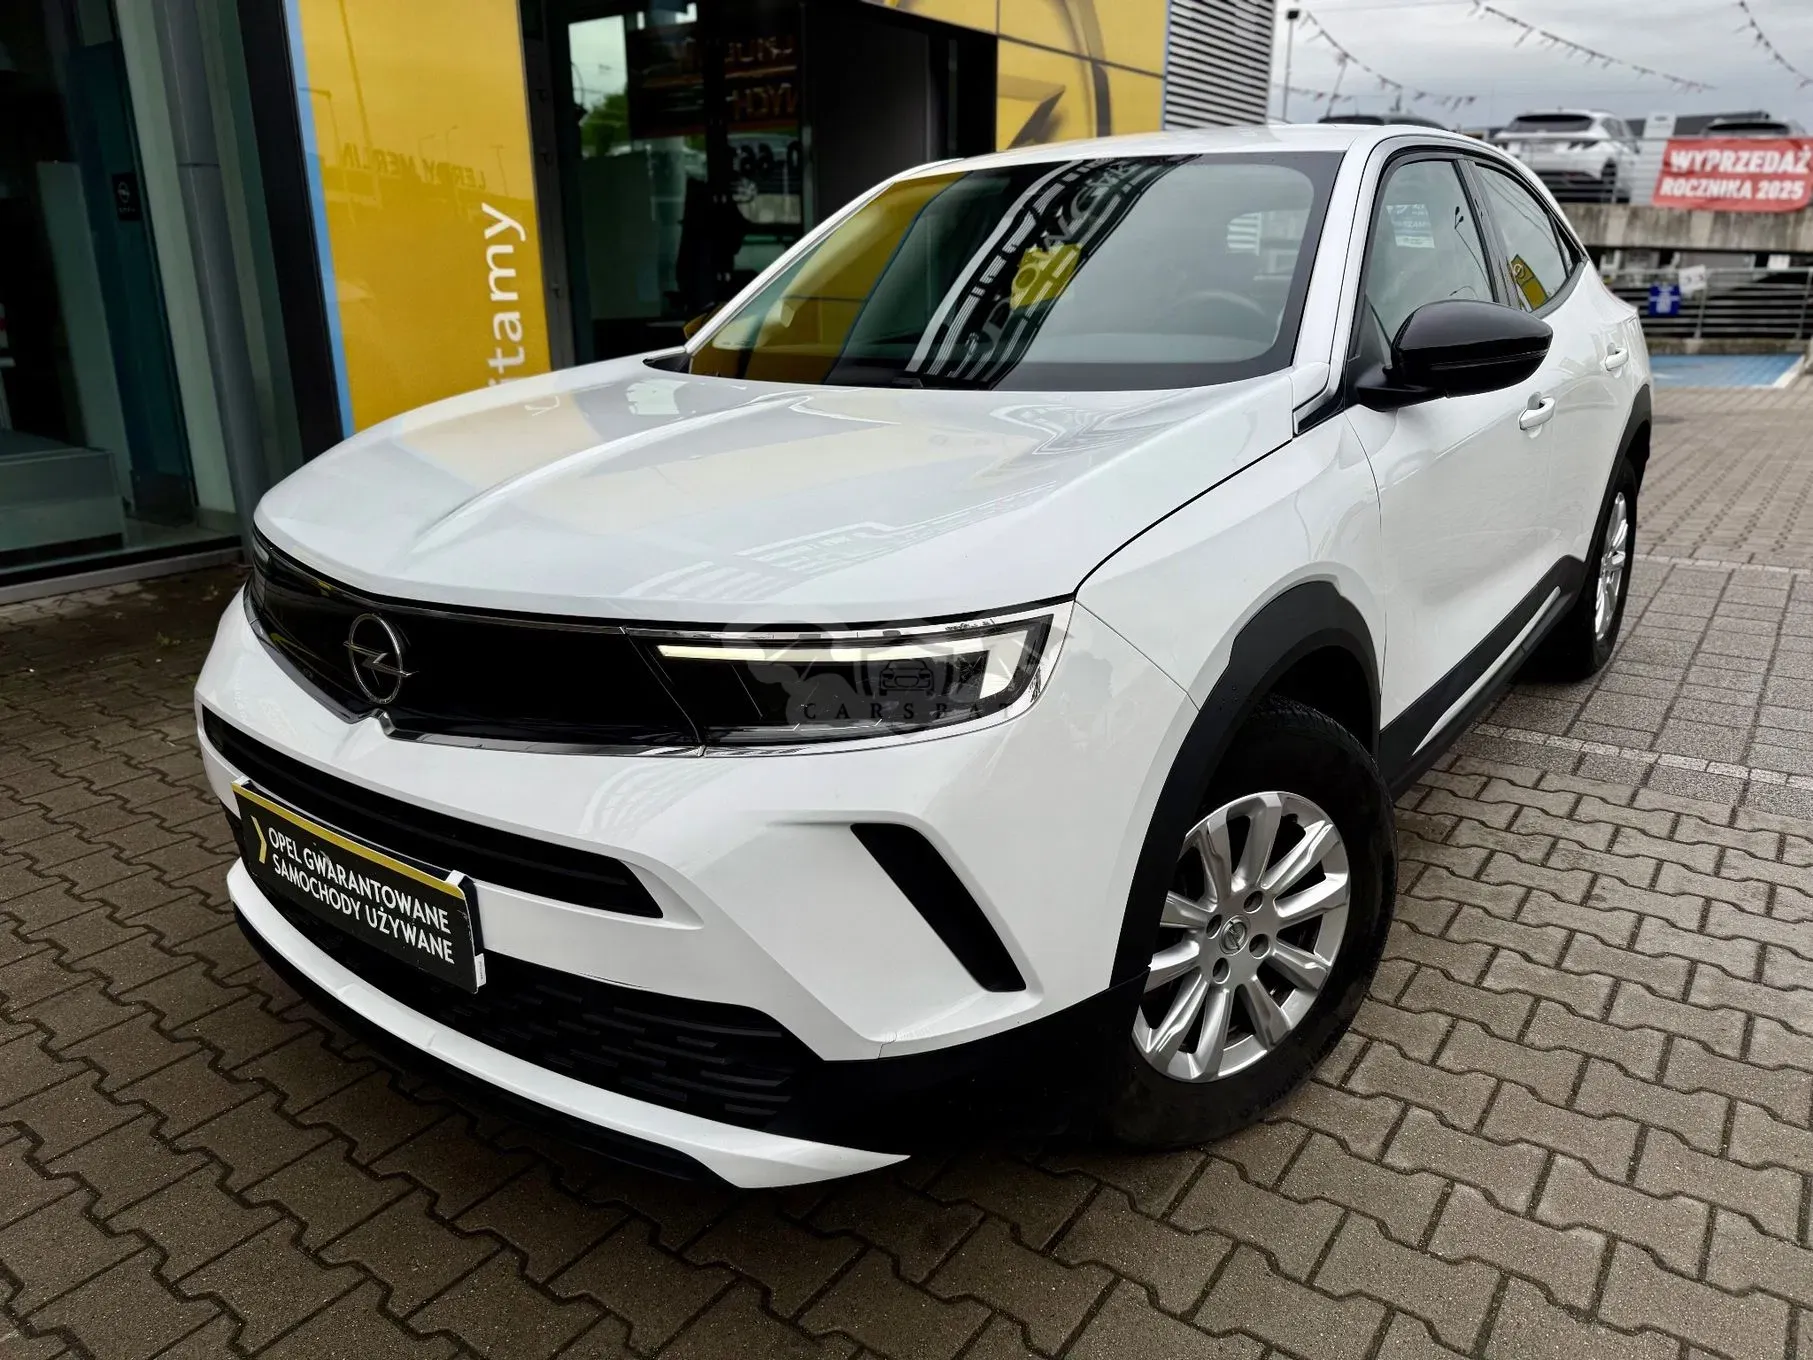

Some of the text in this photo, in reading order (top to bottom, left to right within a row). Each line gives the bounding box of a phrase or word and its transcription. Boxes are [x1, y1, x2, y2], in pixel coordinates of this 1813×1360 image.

[1660, 177, 1804, 200] ROCZNIKA 2025
[1669, 145, 1811, 173] WYPRZEDAŻ
[268, 827, 451, 934] OPEL GWARANTOWANE
[272, 854, 455, 965] SAMOCHODY UŻYWANE
